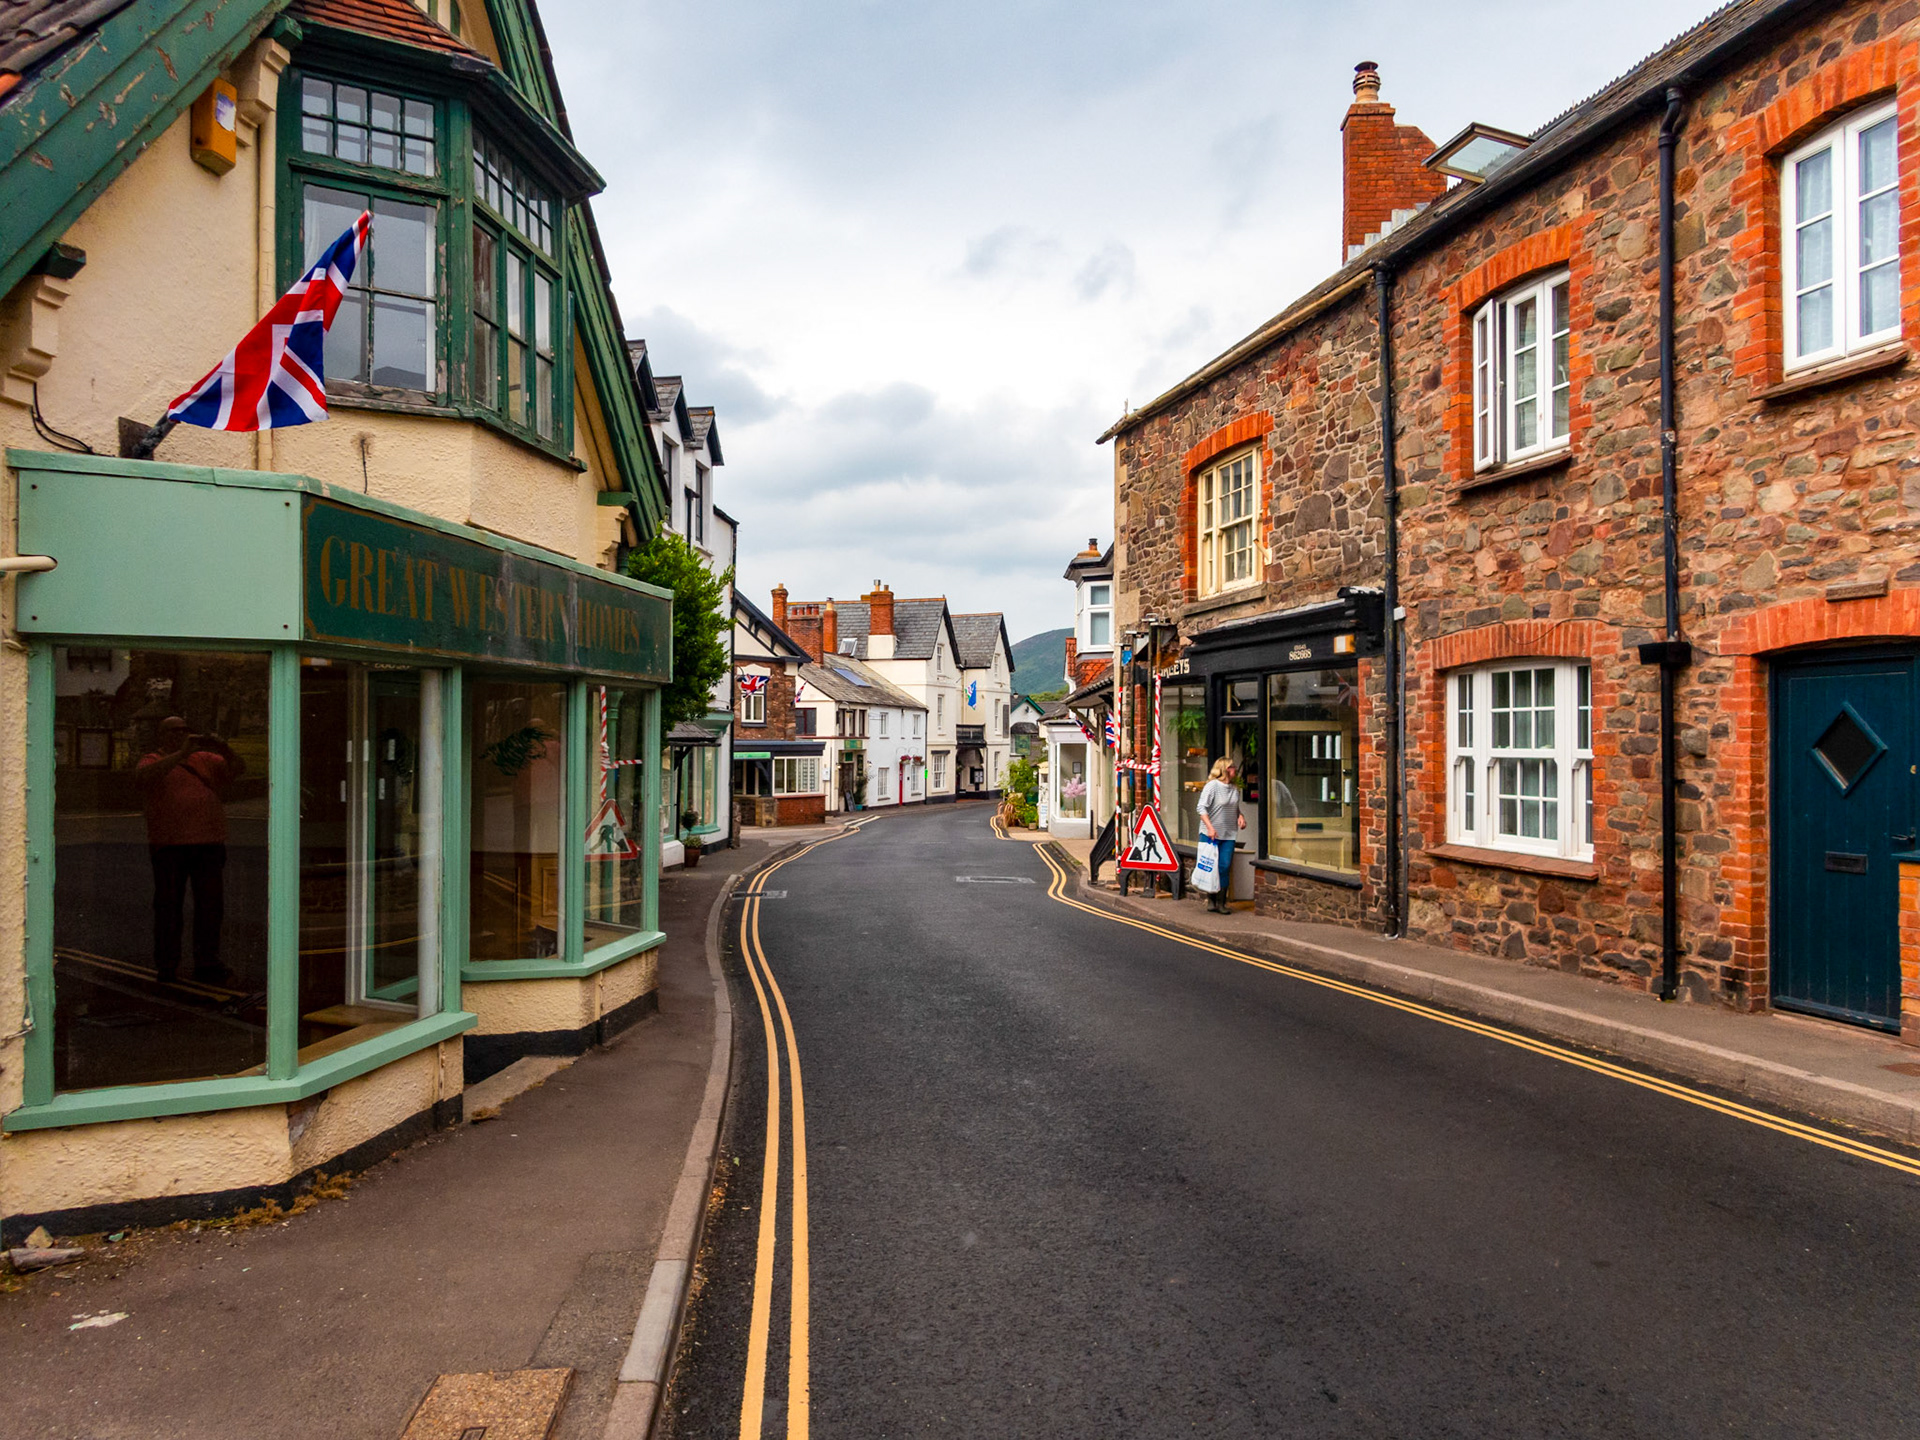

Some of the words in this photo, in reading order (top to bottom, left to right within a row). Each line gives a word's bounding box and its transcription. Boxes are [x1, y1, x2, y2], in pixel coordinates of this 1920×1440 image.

[320, 535, 438, 621] GREAT
[450, 567, 573, 643] WESTERN
[578, 598, 639, 655] HOMES
